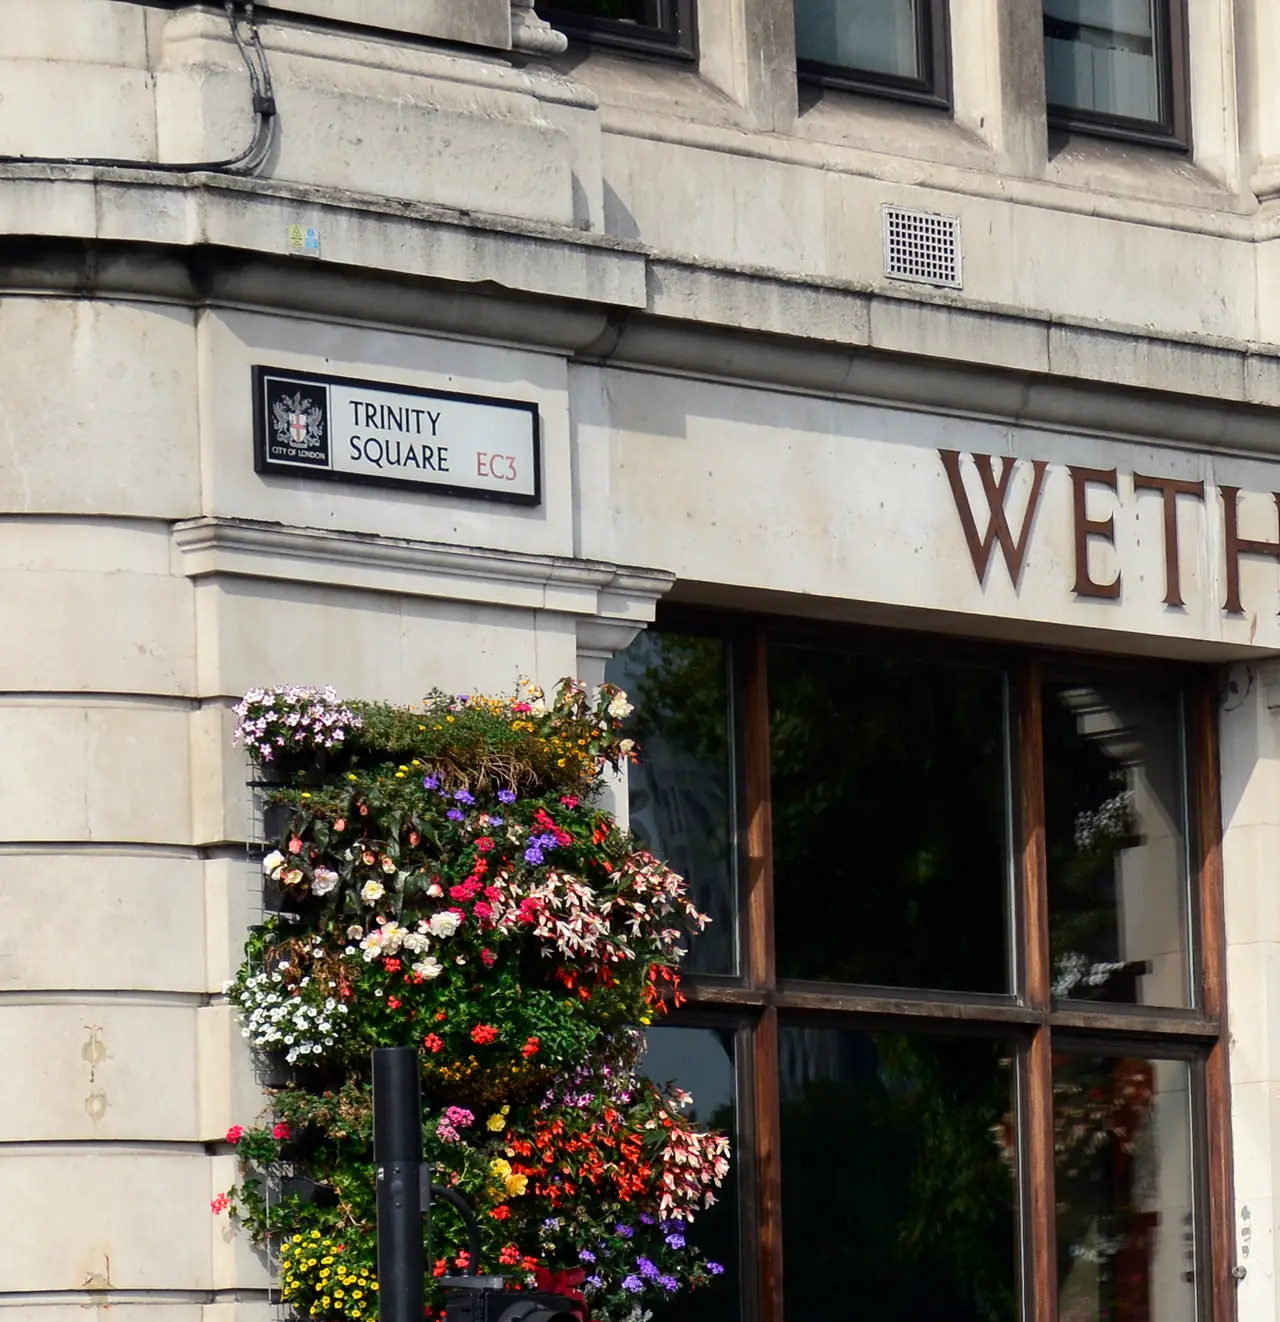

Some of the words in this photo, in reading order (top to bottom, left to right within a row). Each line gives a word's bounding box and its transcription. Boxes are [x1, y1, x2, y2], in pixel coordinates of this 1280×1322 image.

[349, 400, 441, 436] TRINITY
[271, 446, 286, 454] CITY
[287, 448, 297, 456] OF
[298, 449, 326, 459] LONDON
[350, 435, 450, 472] SQUARE
[476, 451, 517, 481] EC3
